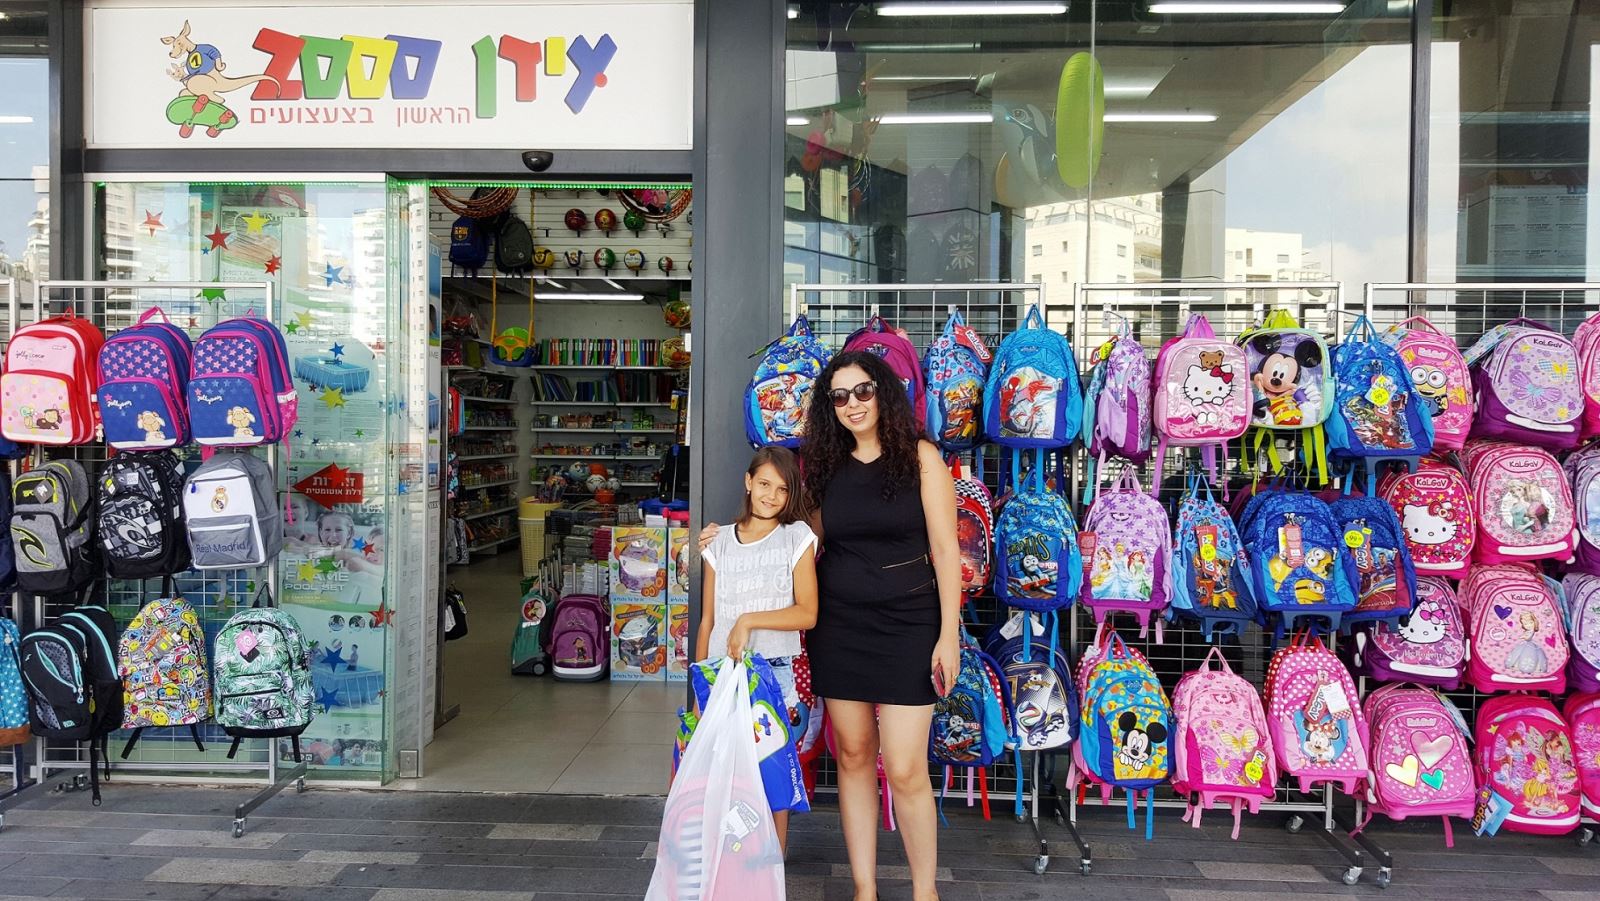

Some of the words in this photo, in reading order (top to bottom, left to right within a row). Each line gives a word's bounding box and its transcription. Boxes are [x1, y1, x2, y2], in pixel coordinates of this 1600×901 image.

[471, 33, 618, 118] עידן
[250, 106, 375, 124] בצעצועים
[396, 106, 471, 127] הראשון
